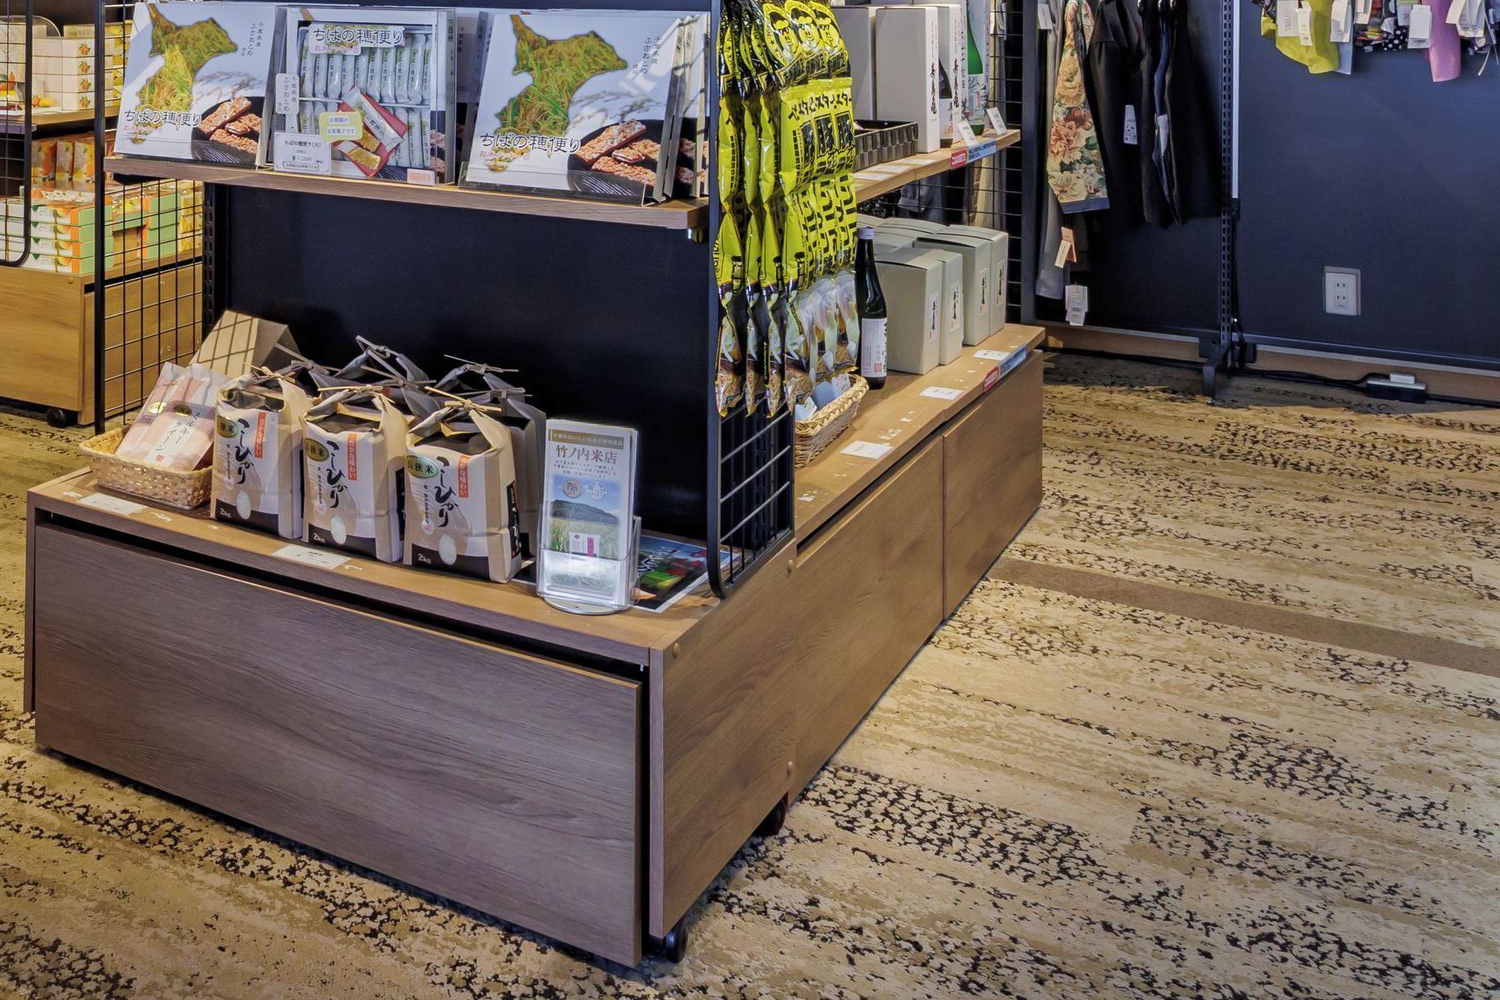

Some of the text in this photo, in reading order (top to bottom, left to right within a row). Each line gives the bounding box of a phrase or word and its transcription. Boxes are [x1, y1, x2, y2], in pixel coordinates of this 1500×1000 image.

[313, 28, 404, 46] ちばの穂便り
[124, 109, 202, 127] ちばの穂便り
[480, 132, 582, 154] ちばの穂便り
[235, 418, 255, 485] こしひかり
[555, 444, 618, 465] 竹ノ内米店
[326, 440, 349, 509] こしひかり
[434, 455, 460, 529] こしひかり
[417, 553, 432, 564] 2kg
